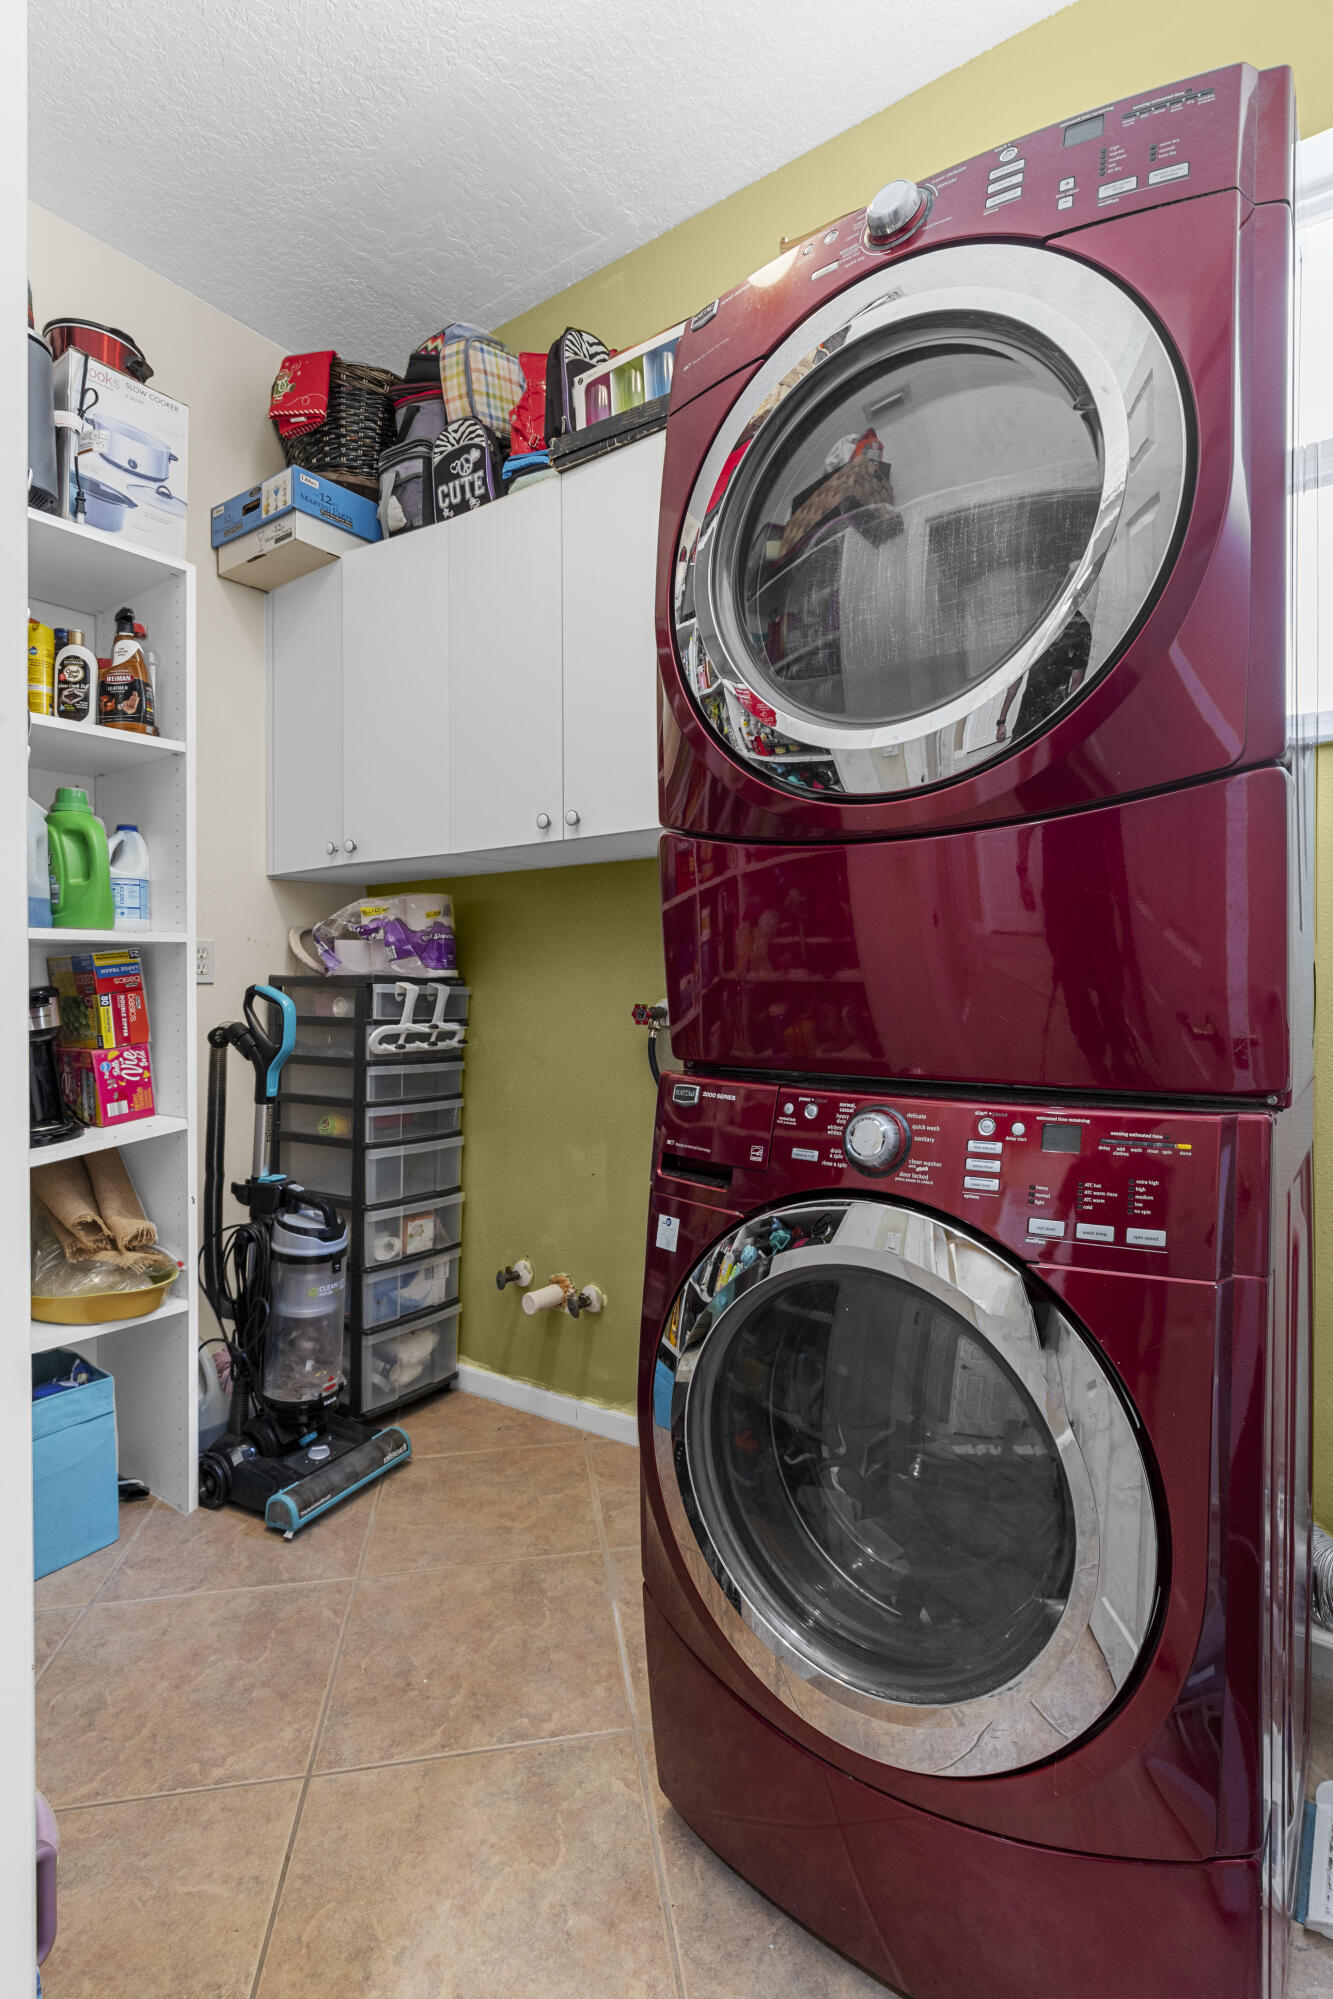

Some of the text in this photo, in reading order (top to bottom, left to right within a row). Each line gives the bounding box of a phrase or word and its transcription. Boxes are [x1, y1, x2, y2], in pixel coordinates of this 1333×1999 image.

[149, 394, 179, 412] COOKER
[437, 470, 486, 509] CUTE
[100, 995, 110, 1006] 80
[127, 993, 137, 1022] basics
[906, 1112, 926, 1120] delicate
[836, 1118, 846, 1126] duty
[926, 1124, 940, 1132] wash
[914, 1135, 936, 1144] sanitary
[923, 1160, 943, 1168] washer
[912, 1172, 929, 1180] locked
